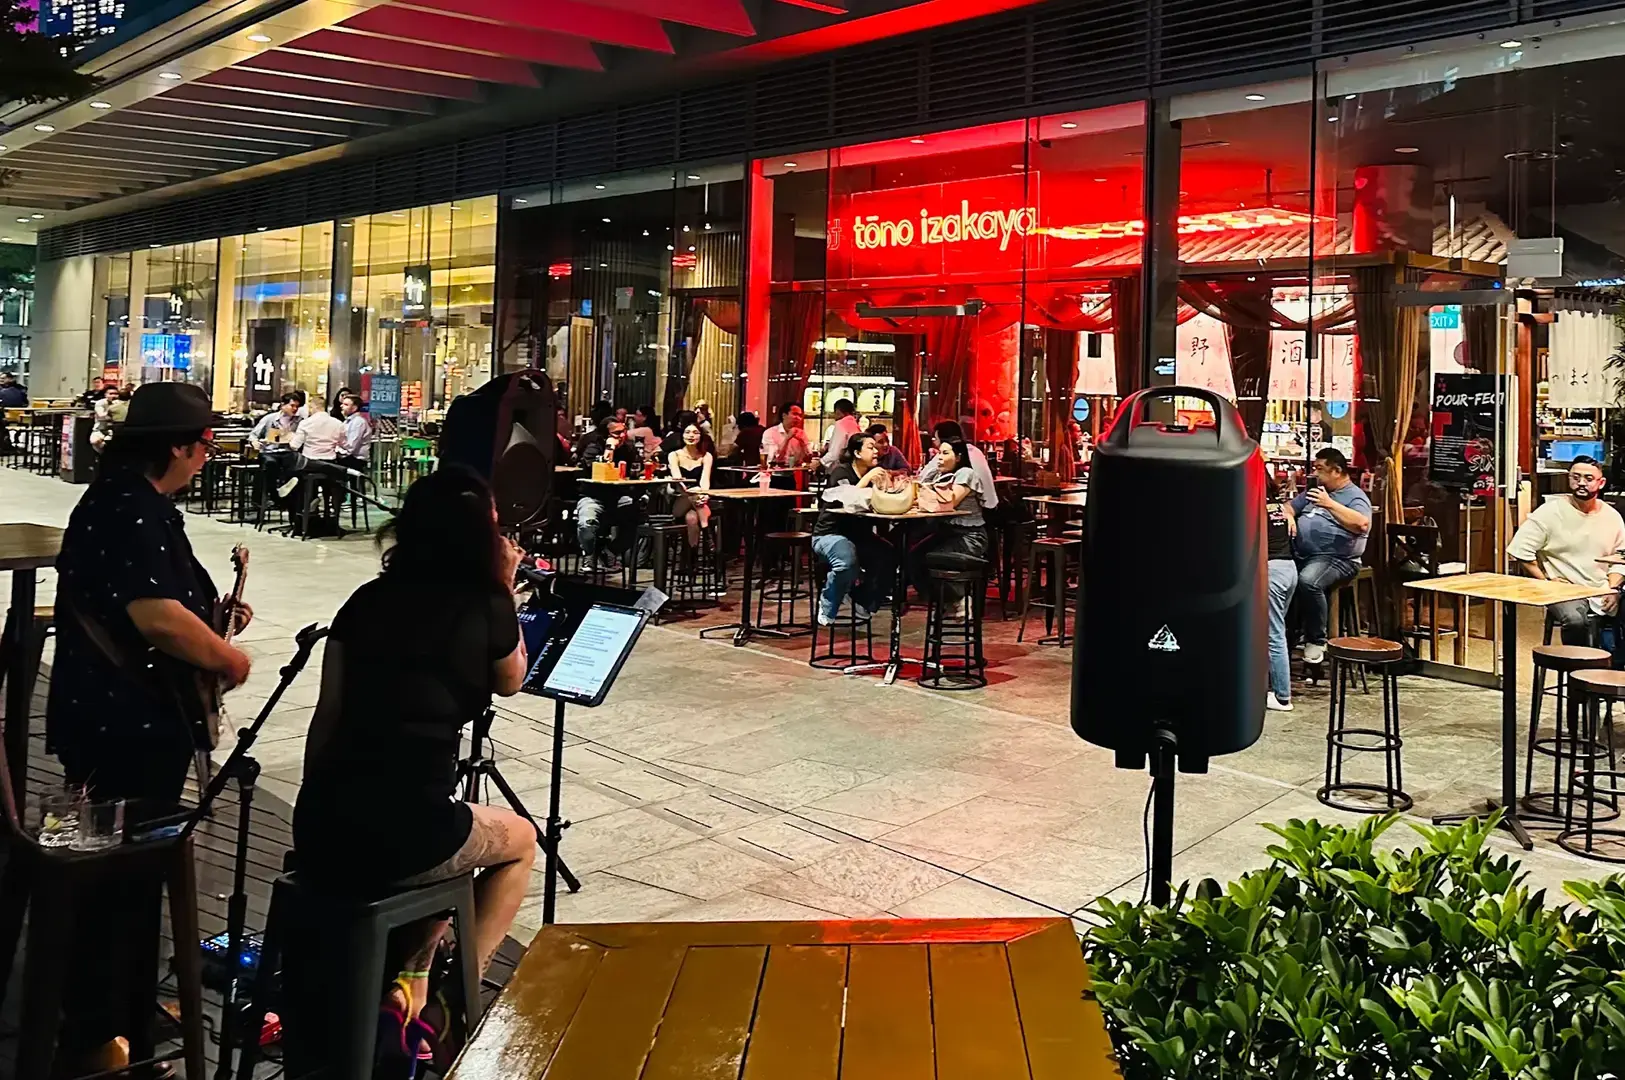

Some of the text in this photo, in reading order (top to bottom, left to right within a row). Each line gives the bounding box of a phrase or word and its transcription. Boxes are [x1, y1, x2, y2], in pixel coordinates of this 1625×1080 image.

[853, 216, 914, 249] tōno
[920, 200, 1036, 251] izakaya
[370, 390, 398, 402] EVENT
